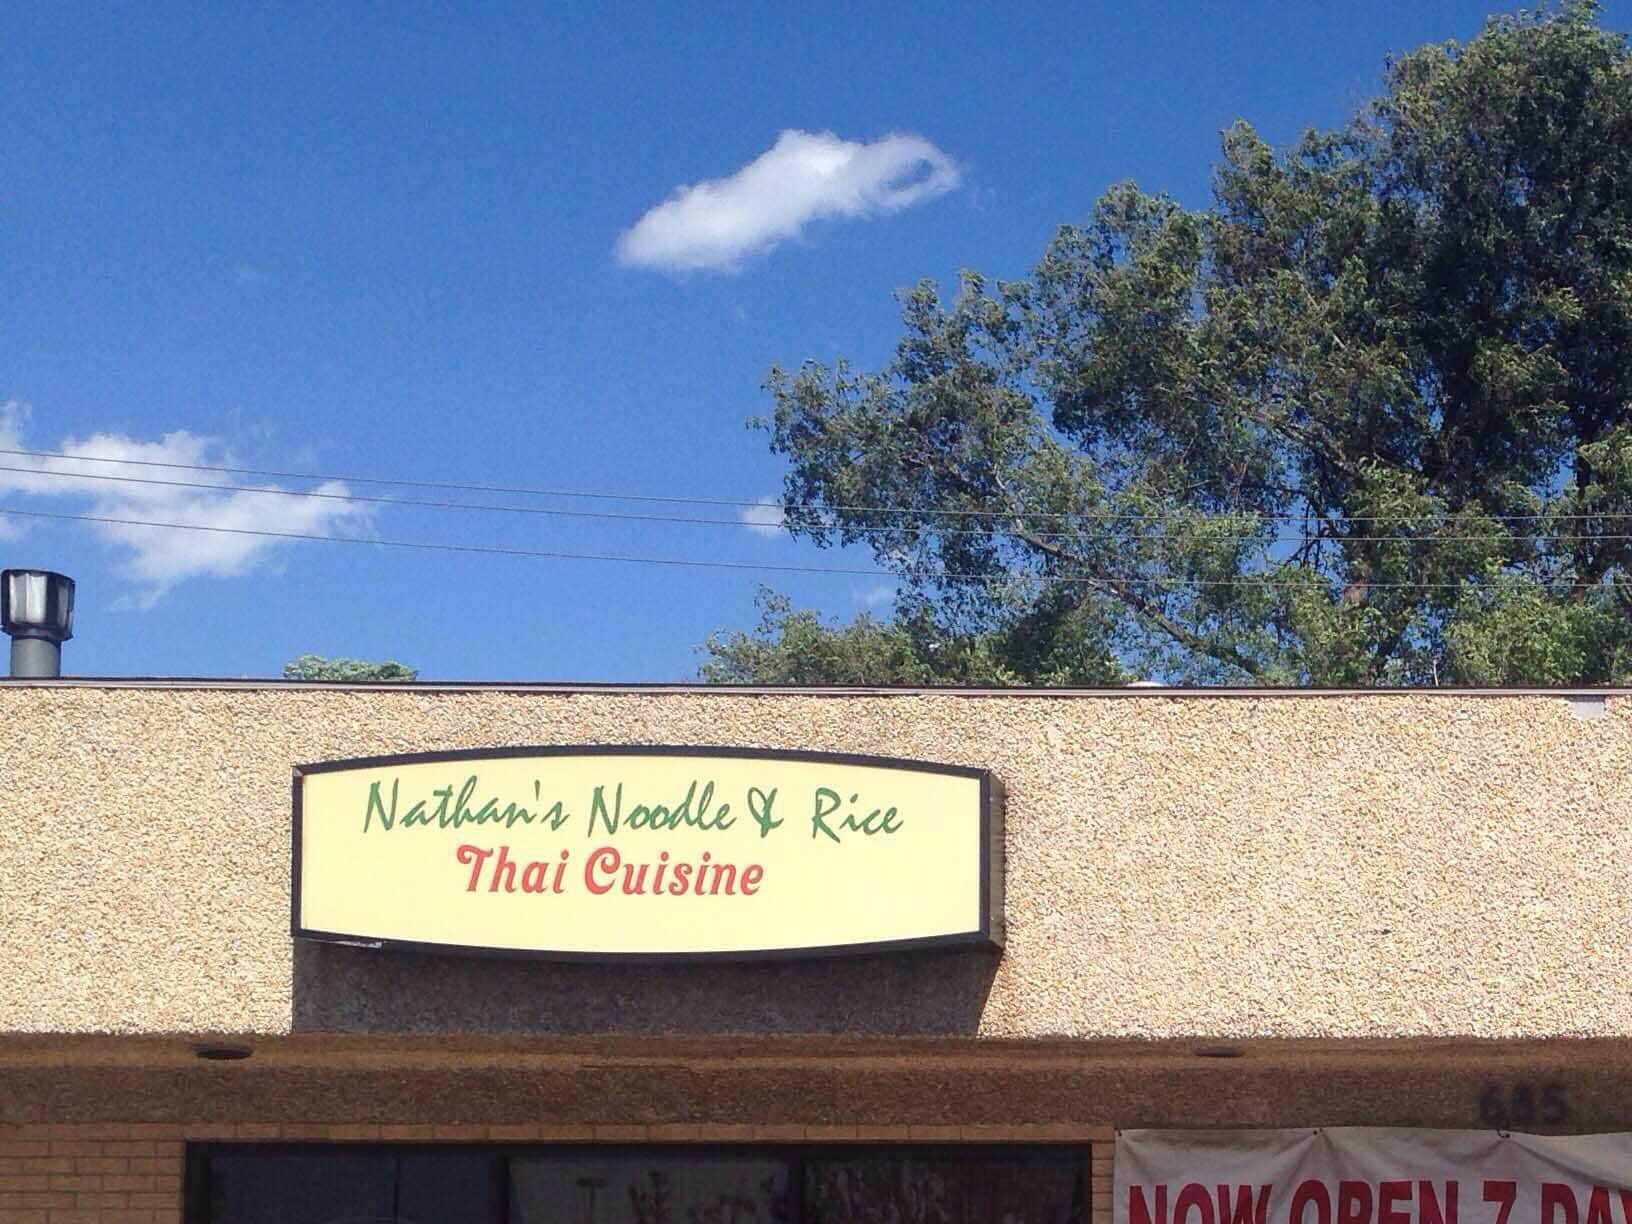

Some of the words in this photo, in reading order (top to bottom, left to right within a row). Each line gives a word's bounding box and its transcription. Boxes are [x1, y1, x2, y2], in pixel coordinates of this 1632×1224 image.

[364, 776, 570, 836] Nathan's
[587, 779, 737, 838] Noodle
[748, 787, 784, 838] &
[811, 786, 904, 843] Rice
[456, 845, 569, 894] Thai
[584, 846, 764, 896] Cuisine
